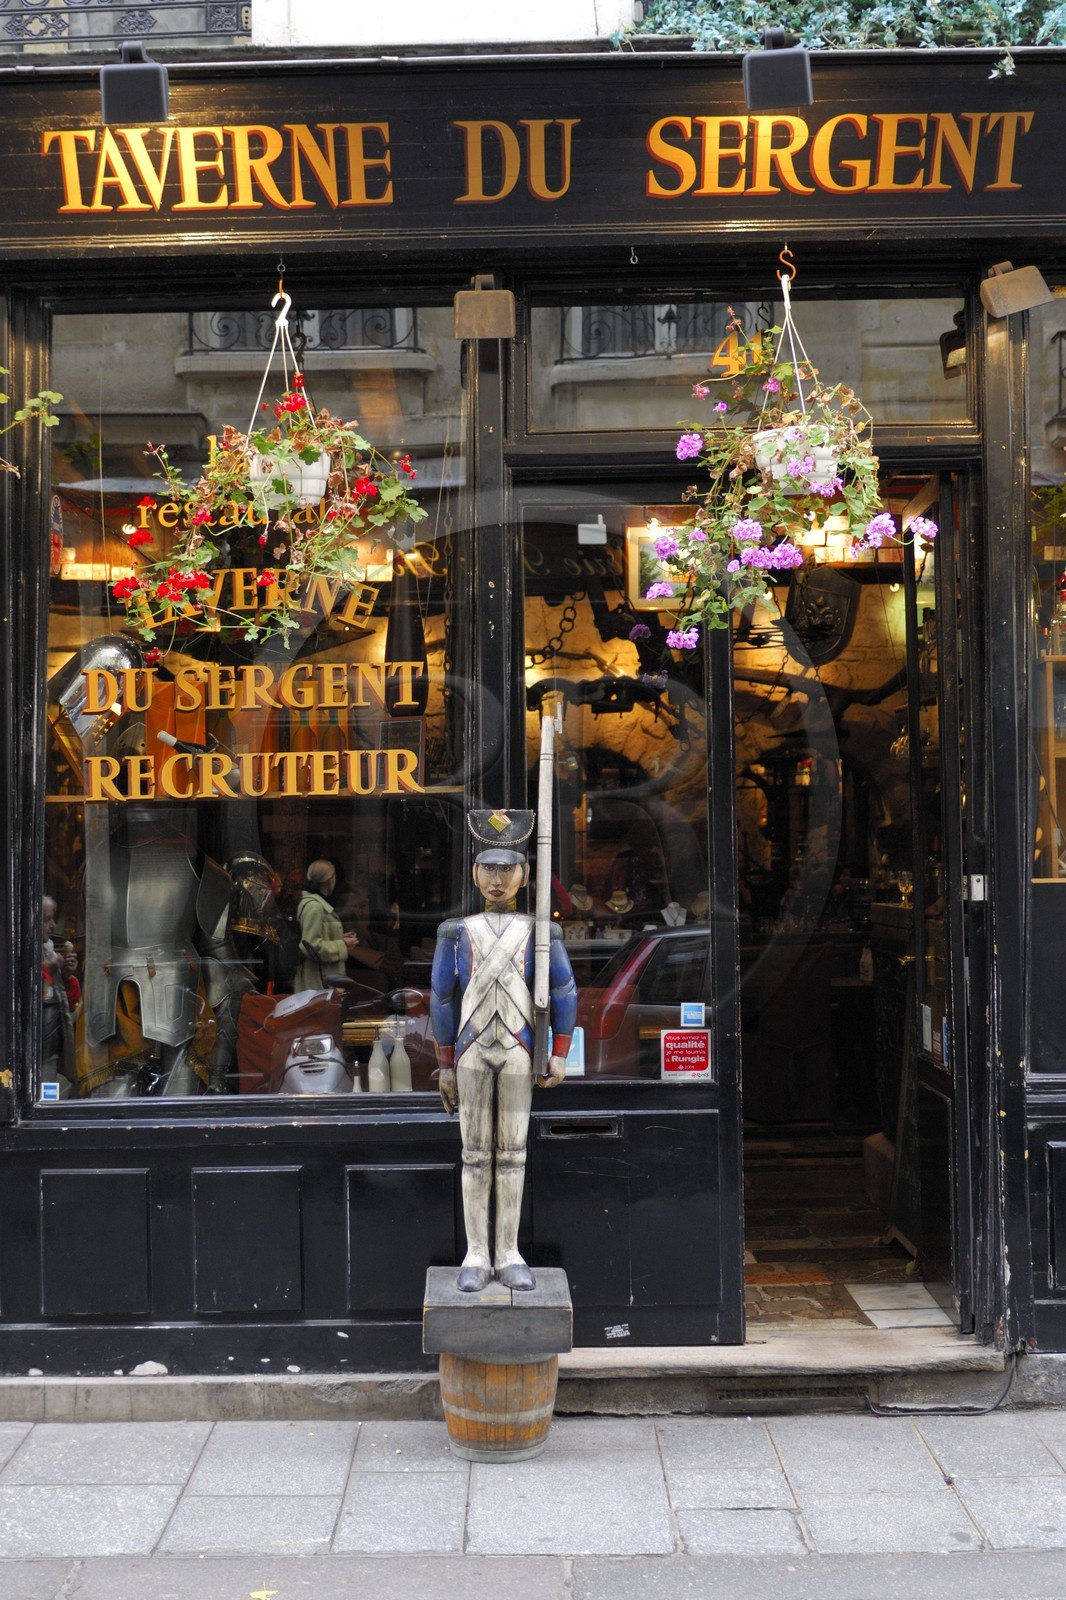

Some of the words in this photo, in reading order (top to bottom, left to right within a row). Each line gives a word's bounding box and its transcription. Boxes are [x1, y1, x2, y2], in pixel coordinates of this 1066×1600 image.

[41, 121, 394, 213] TAVERNE
[451, 118, 581, 204] DU
[646, 111, 1035, 197] SERGENT
[136, 495, 353, 529] reaua
[80, 667, 159, 714] DU
[172, 661, 425, 713] SERGENT
[84, 749, 426, 803] RECRUTEUR
[666, 1041, 705, 1050] qualité
[671, 1055, 705, 1063] Rungis
